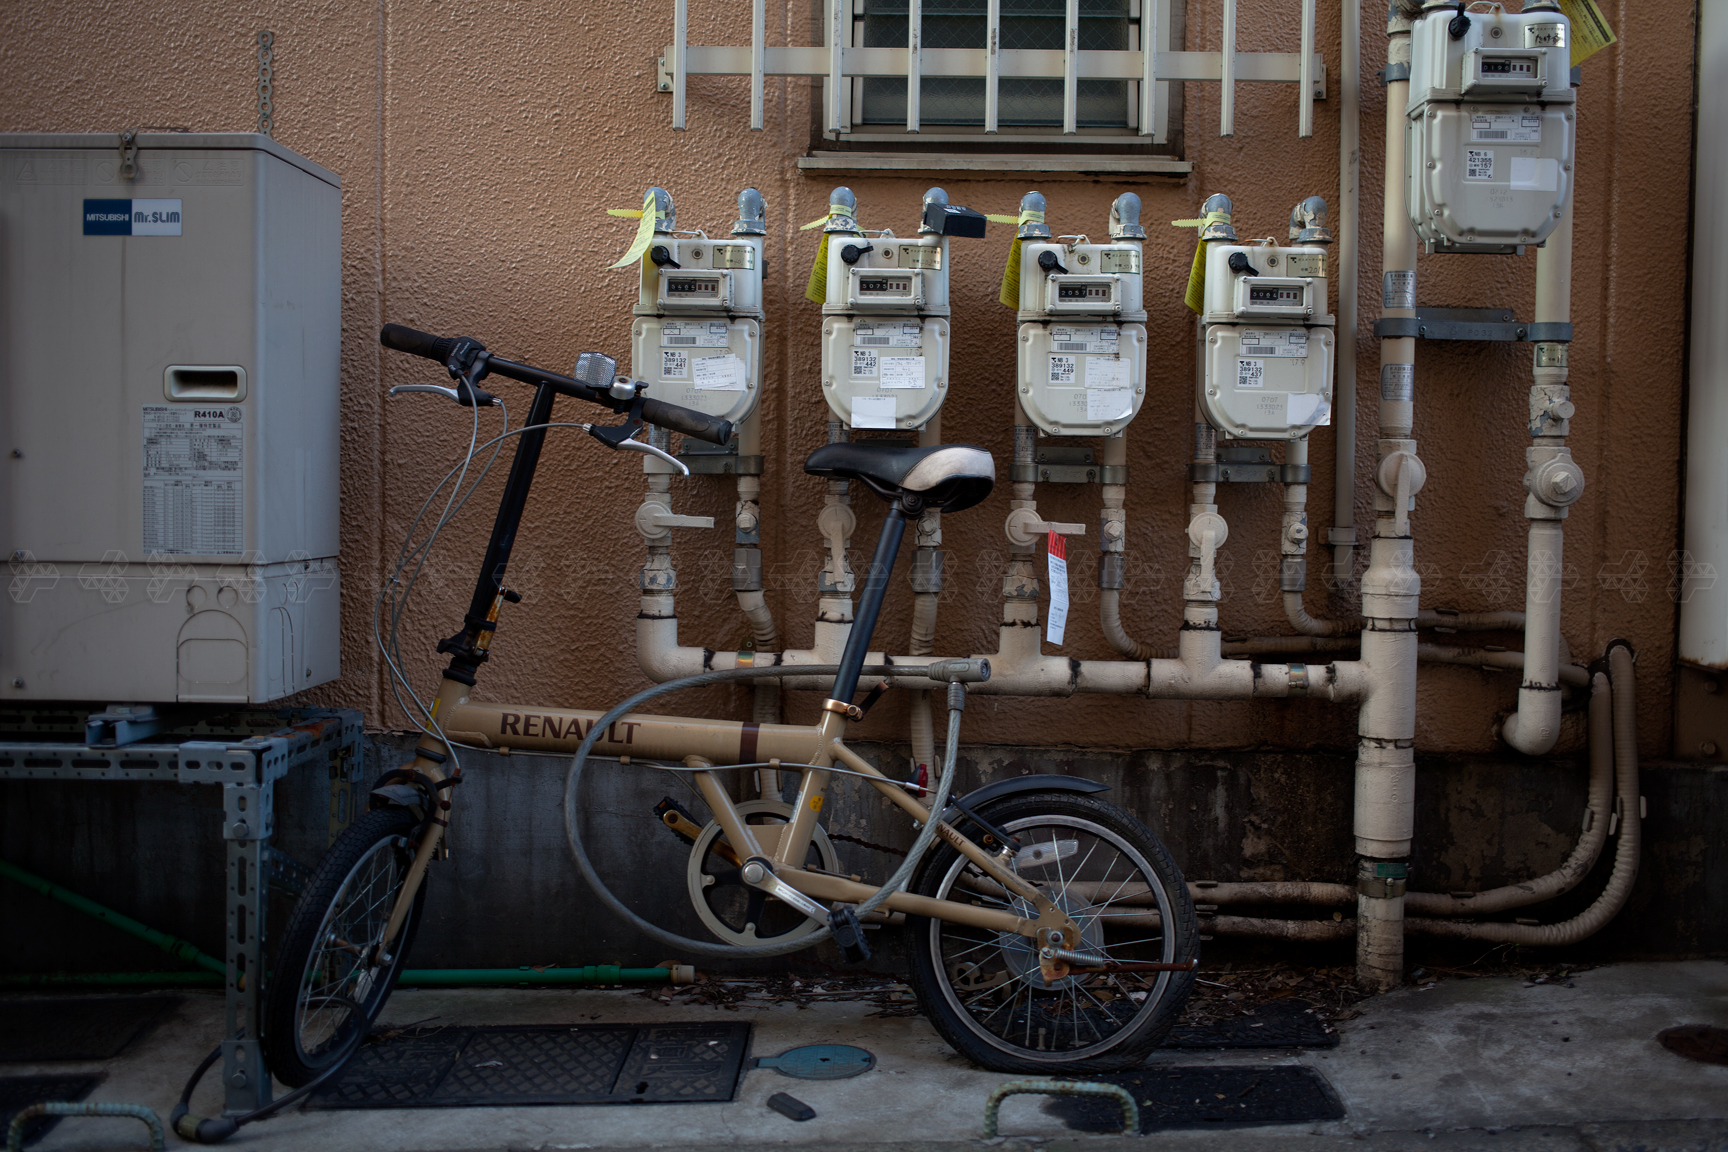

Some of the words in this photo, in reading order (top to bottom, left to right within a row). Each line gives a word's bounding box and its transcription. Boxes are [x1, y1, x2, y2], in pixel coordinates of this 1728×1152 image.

[134, 212, 180, 223] Mr.SLIM
[500, 712, 641, 744] RENAULT
[937, 822, 966, 846] NAULT
